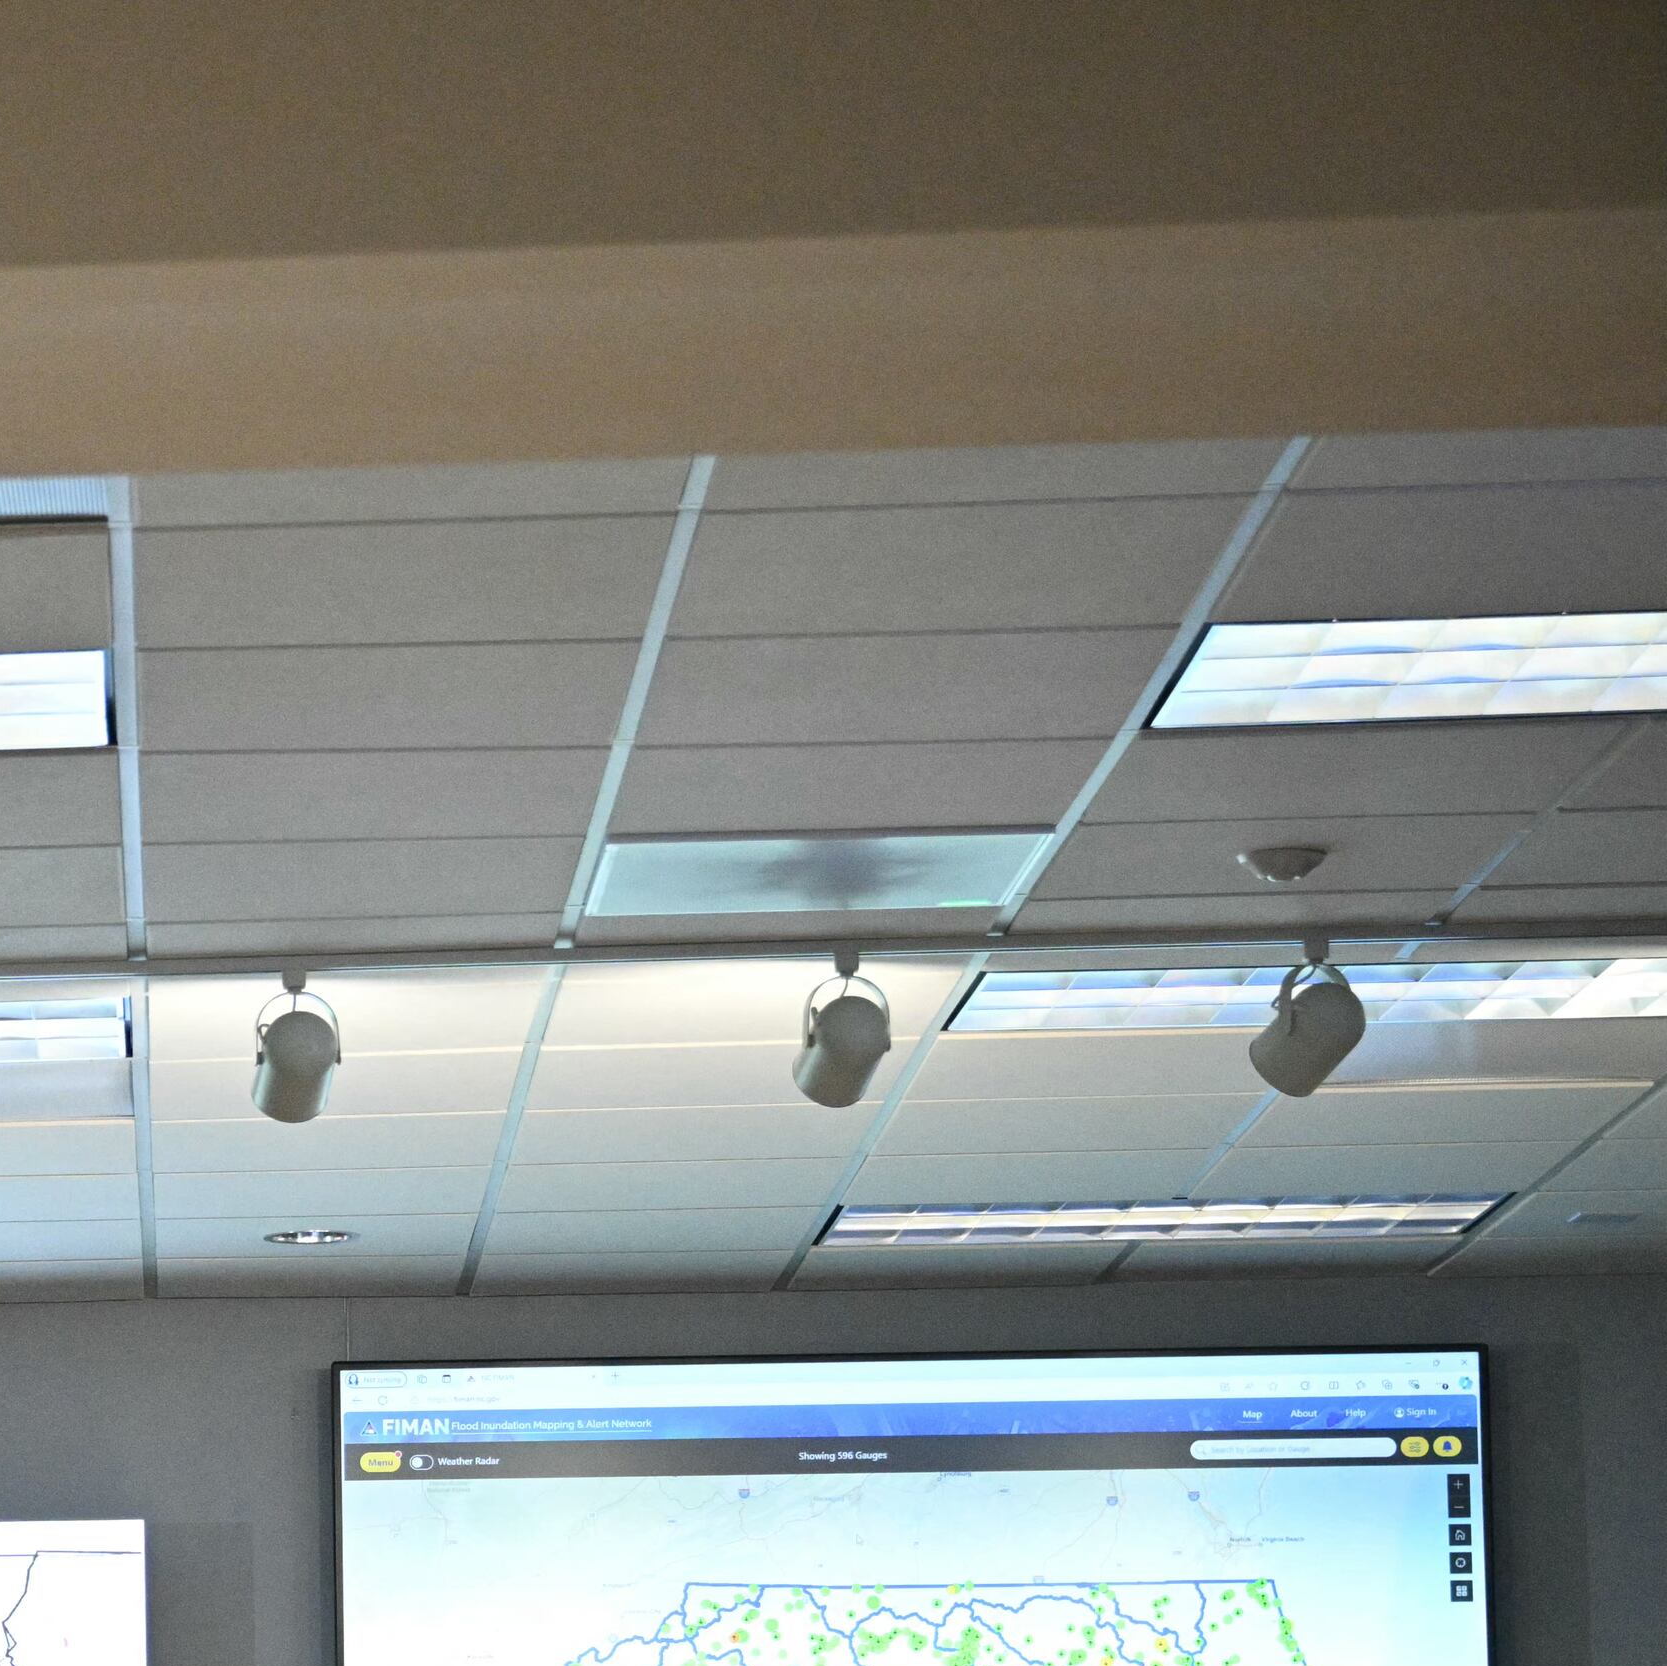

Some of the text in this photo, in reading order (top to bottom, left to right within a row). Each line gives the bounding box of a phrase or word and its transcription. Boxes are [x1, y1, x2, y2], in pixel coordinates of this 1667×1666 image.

[1243, 1411, 1263, 1420] Map
[1291, 1410, 1317, 1418] About
[1346, 1409, 1366, 1418] Help
[1406, 1408, 1426, 1416] Sign
[383, 1418, 652, 1436] FIMAN Flood Inundation Mapping & Alert Network
[438, 1456, 499, 1466] Weather Radar
[799, 1452, 836, 1462] Showing
[855, 1451, 888, 1462] Gauges
[368, 1459, 393, 1467] Menu
